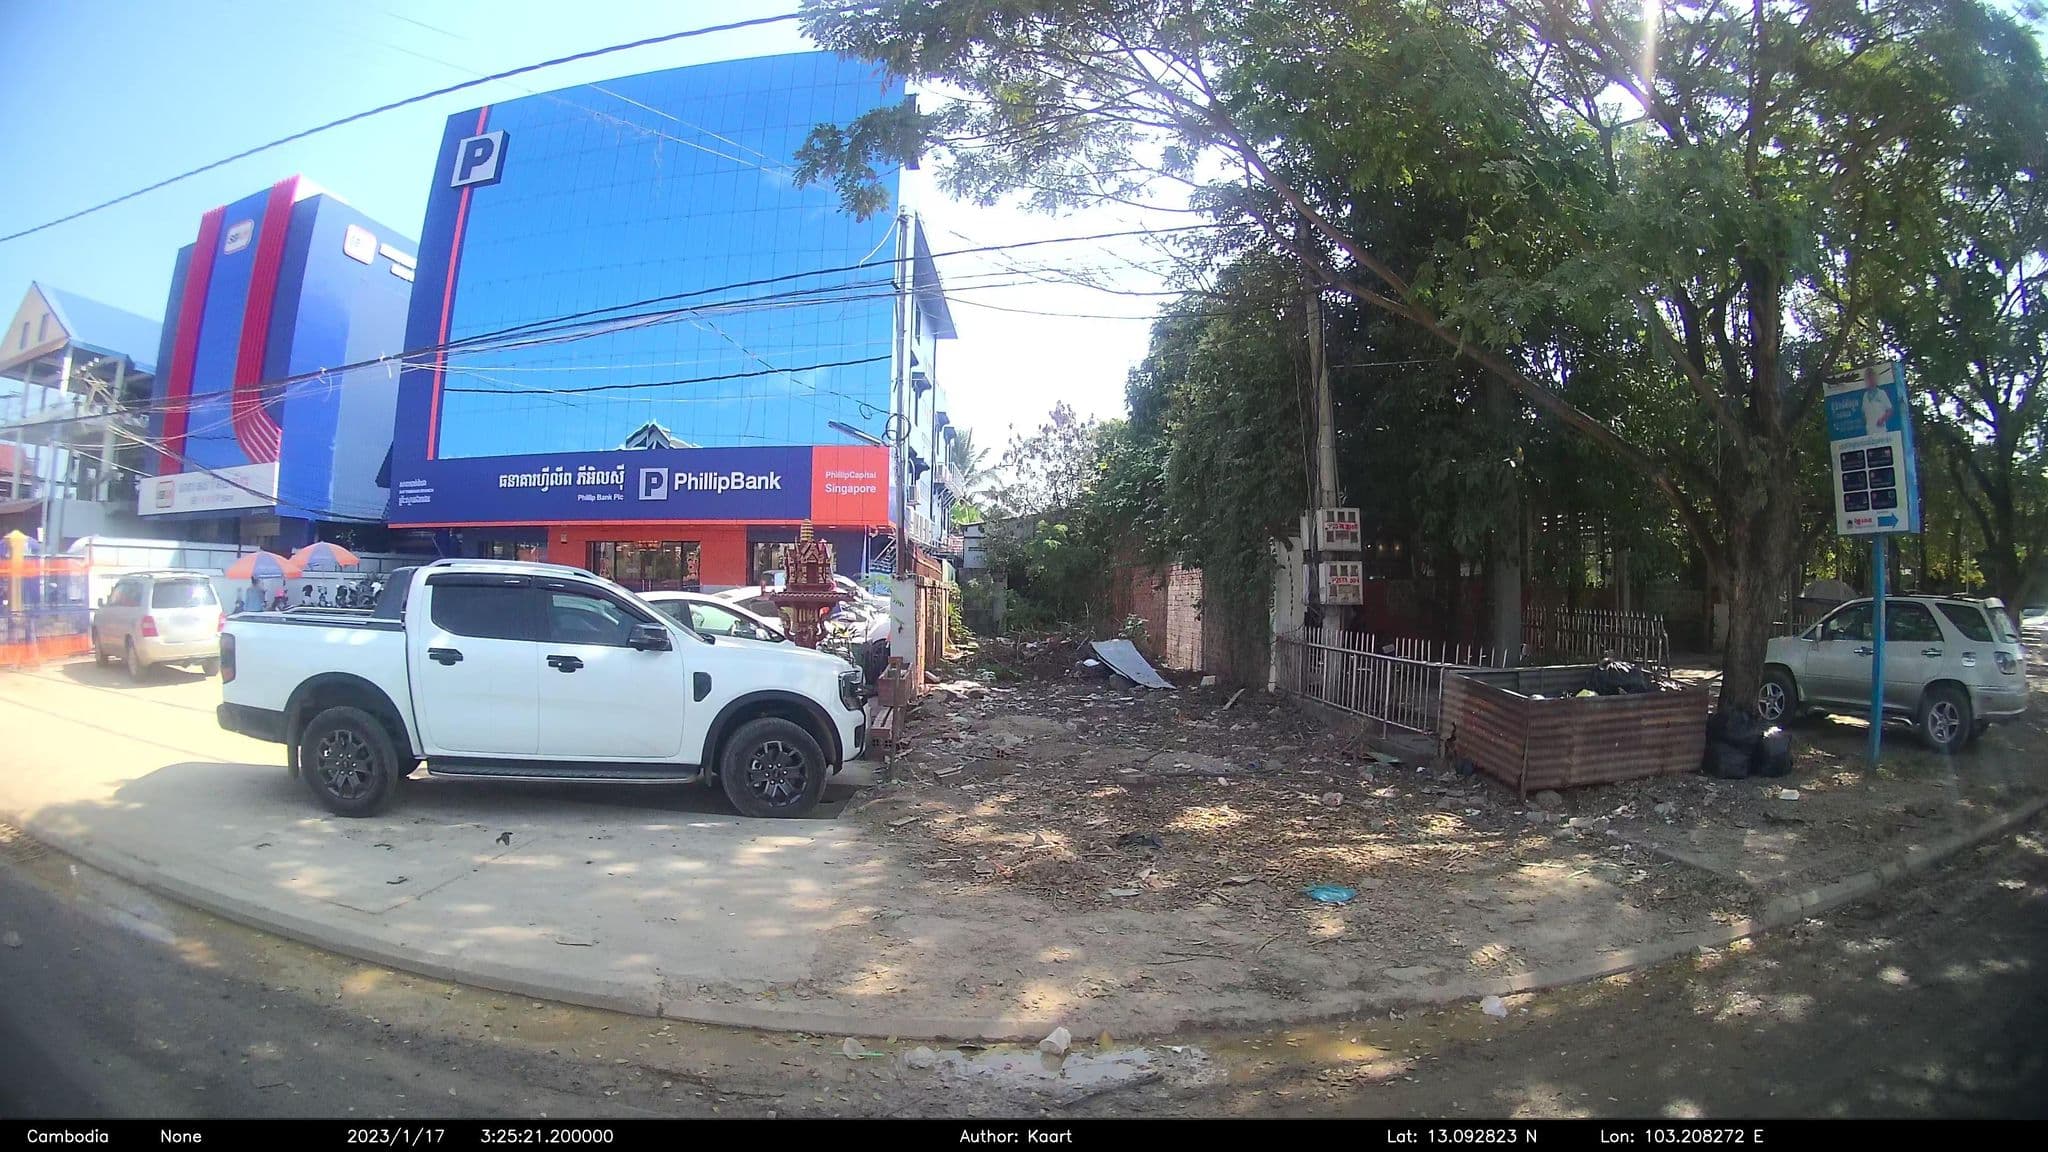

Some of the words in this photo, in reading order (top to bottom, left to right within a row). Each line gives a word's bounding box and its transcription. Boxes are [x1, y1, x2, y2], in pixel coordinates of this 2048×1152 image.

[459, 137, 495, 181] P
[644, 471, 664, 497] P
[674, 471, 782, 494] PhillipBank
[825, 471, 877, 480] PhillipCapital
[577, 494, 596, 502] Phillip
[597, 493, 613, 501] Bank
[825, 483, 877, 495] Singapore
